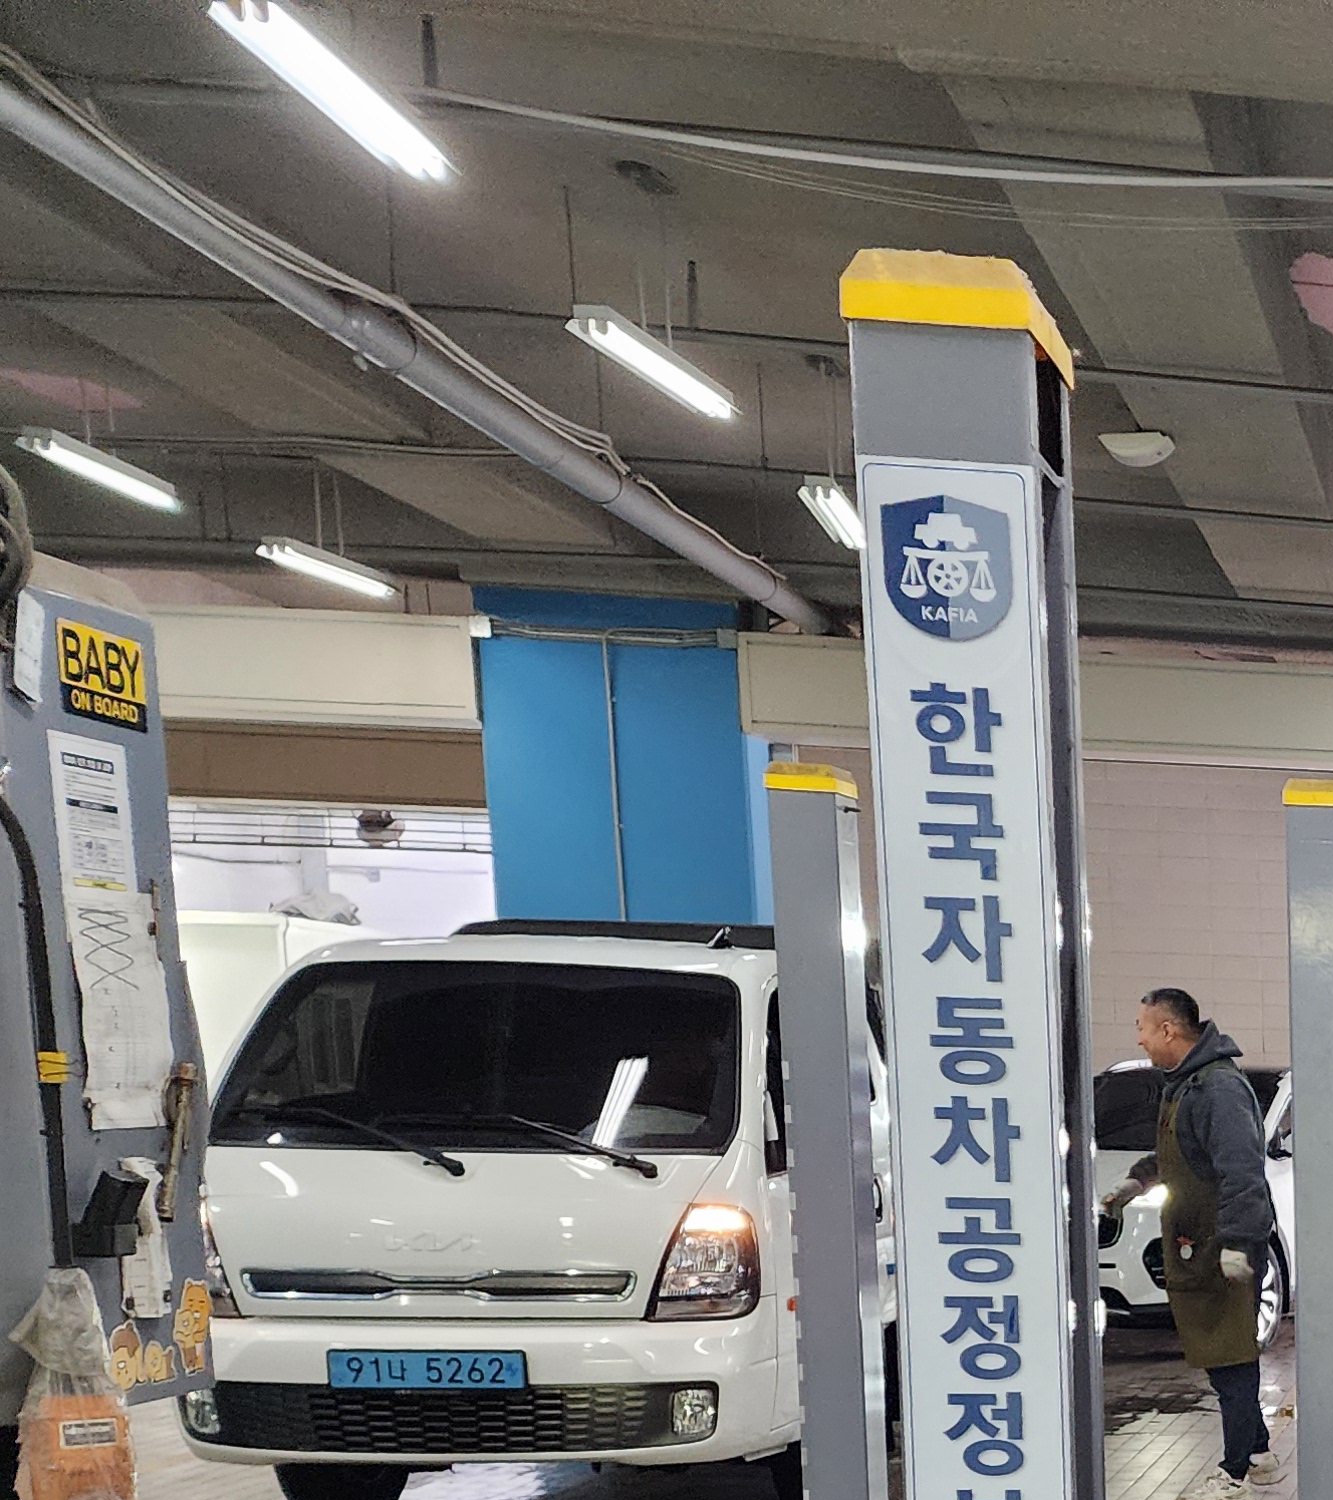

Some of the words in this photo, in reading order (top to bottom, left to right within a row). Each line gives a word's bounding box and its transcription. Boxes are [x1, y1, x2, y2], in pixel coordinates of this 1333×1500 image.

[921, 605, 979, 624] KAFIA
[62, 626, 140, 698] BABY
[71, 688, 91, 712] ON
[94, 694, 139, 723] BOARD
[425, 1357, 506, 1384] 5262
